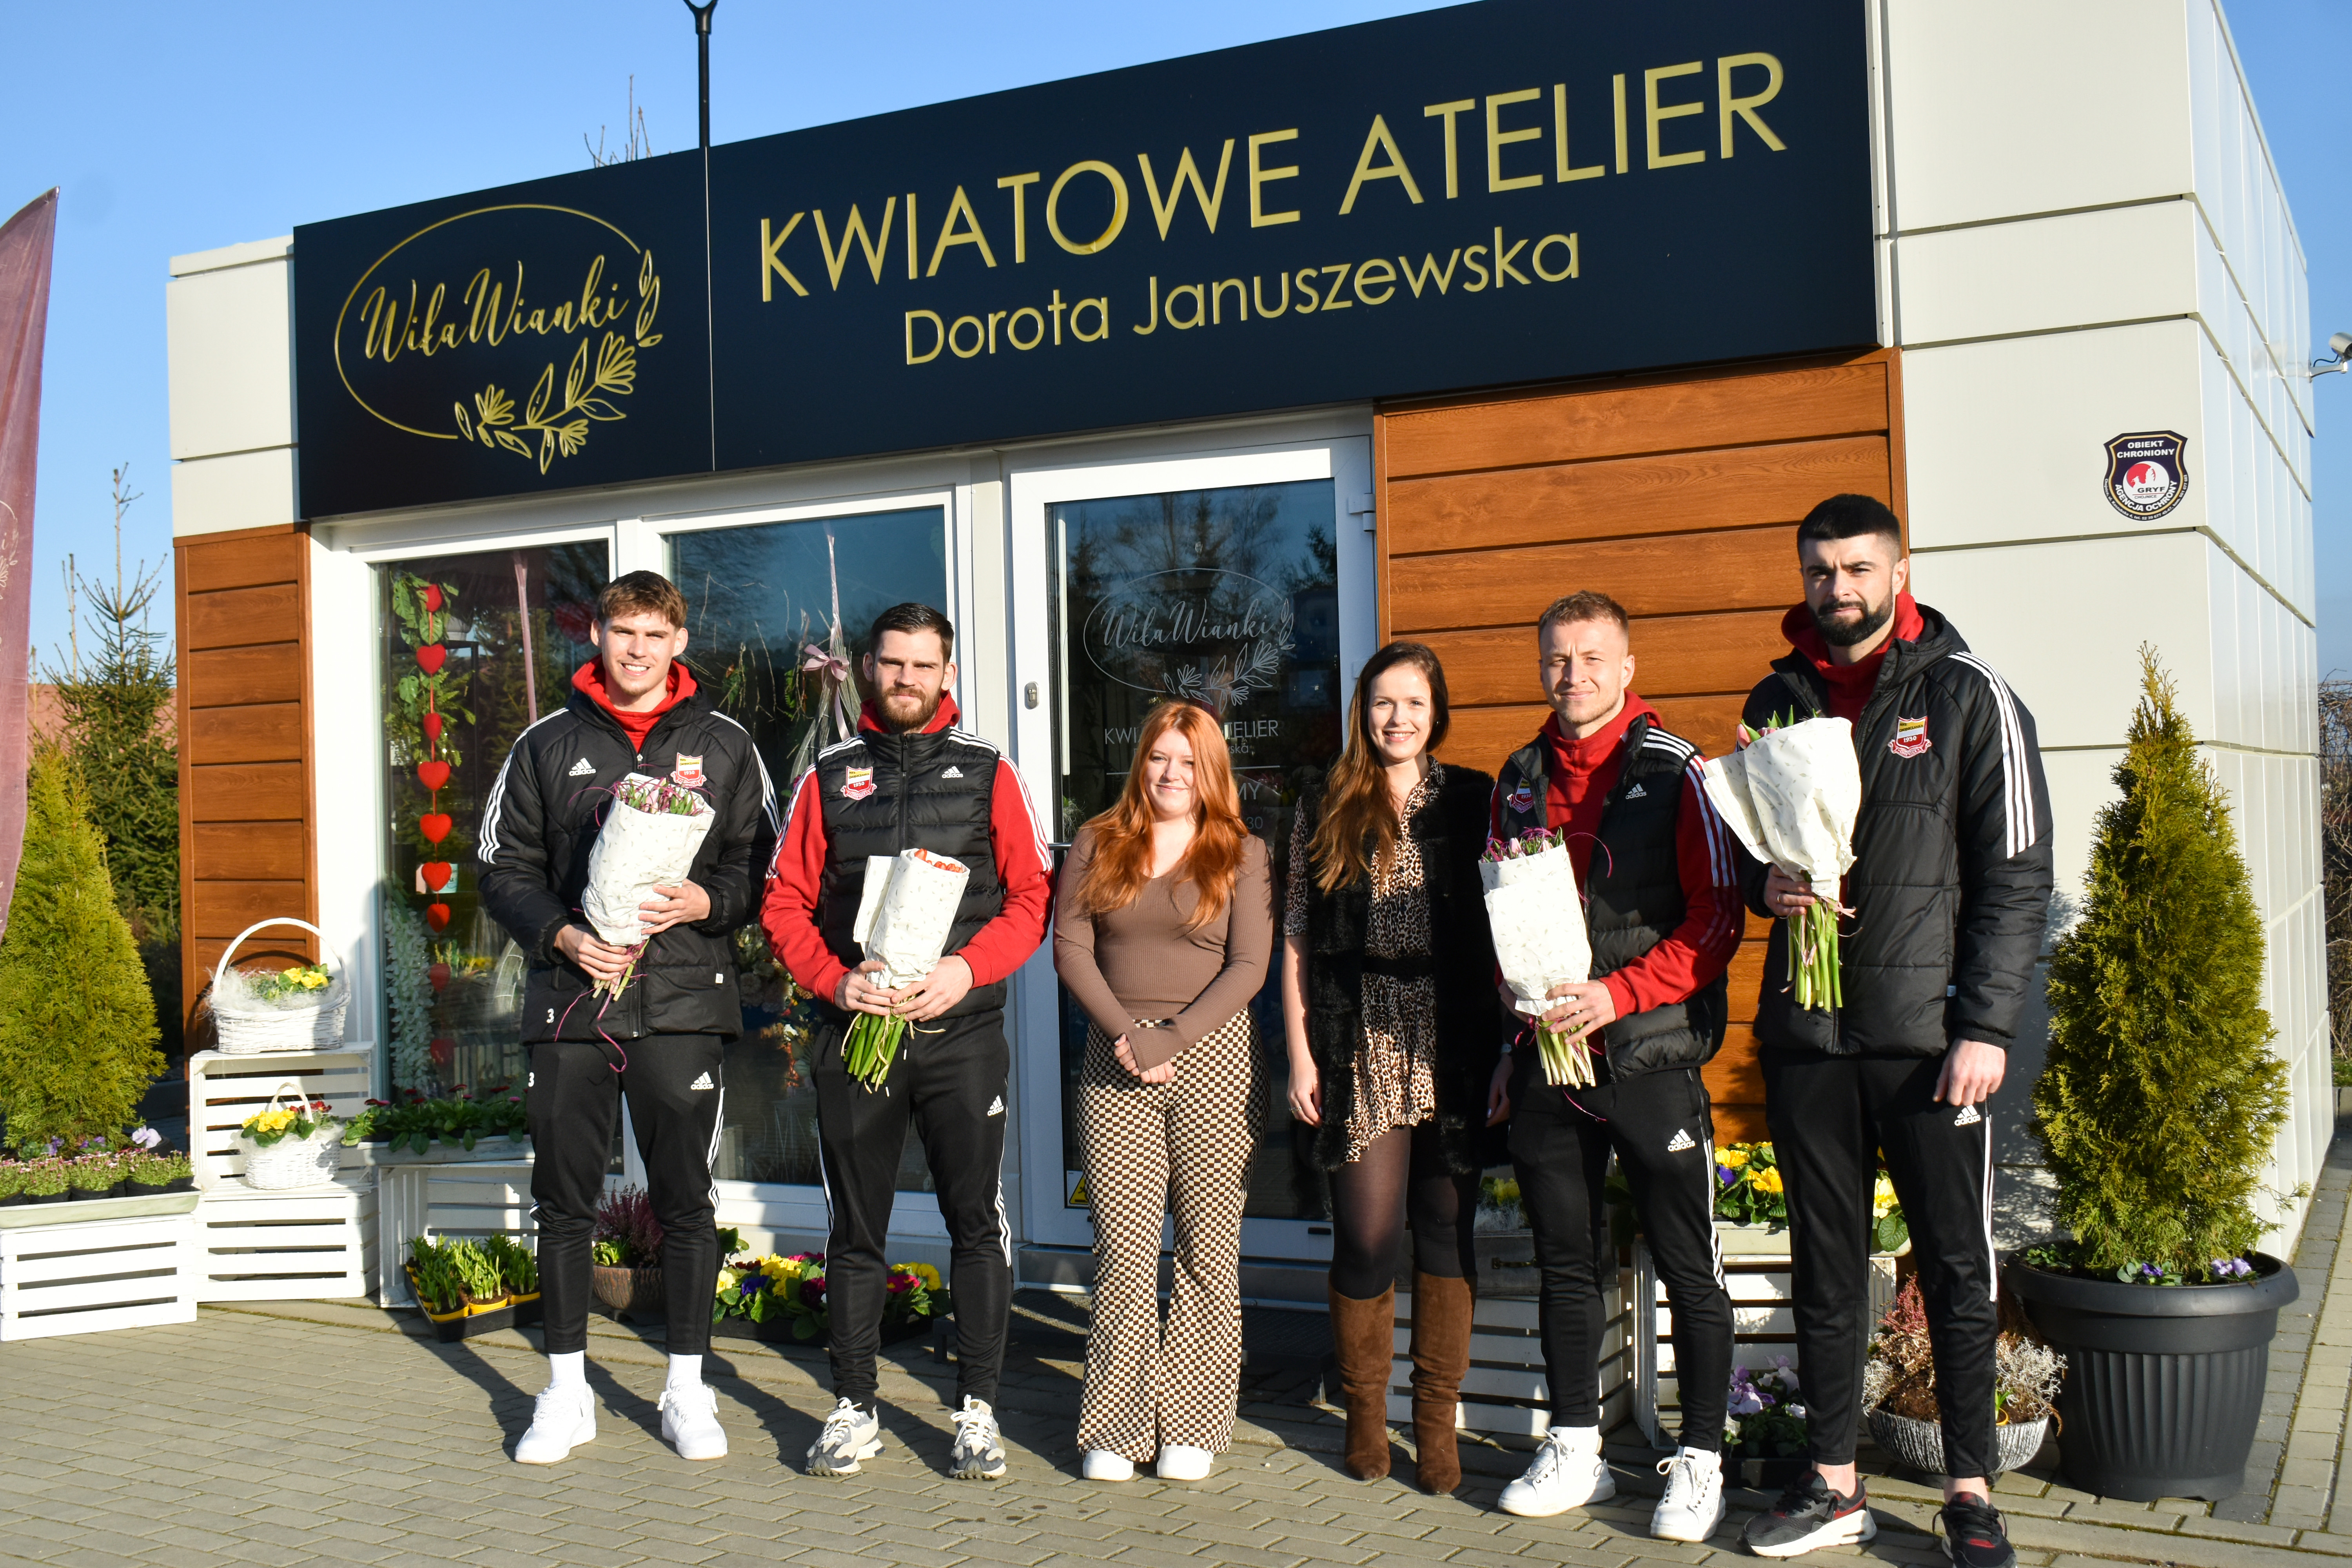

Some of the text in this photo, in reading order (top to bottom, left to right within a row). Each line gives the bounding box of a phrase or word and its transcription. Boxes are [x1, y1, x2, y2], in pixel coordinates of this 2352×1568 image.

[762, 52, 1786, 302] KWIATOWE ATELIER
[906, 226, 1579, 365] Dorota Januszewska
[2117, 449, 2175, 458] CHRONIONY
[2115, 481, 2177, 512] AGENCJA OCHRONY
[1222, 720, 1278, 739] TELIER
[546, 1008, 554, 1023] 3
[528, 1072, 534, 1087] 3
[987, 1105, 1004, 1116] adidas
[1954, 1114, 1980, 1126] adidas
[1668, 1140, 1695, 1152] adidas
